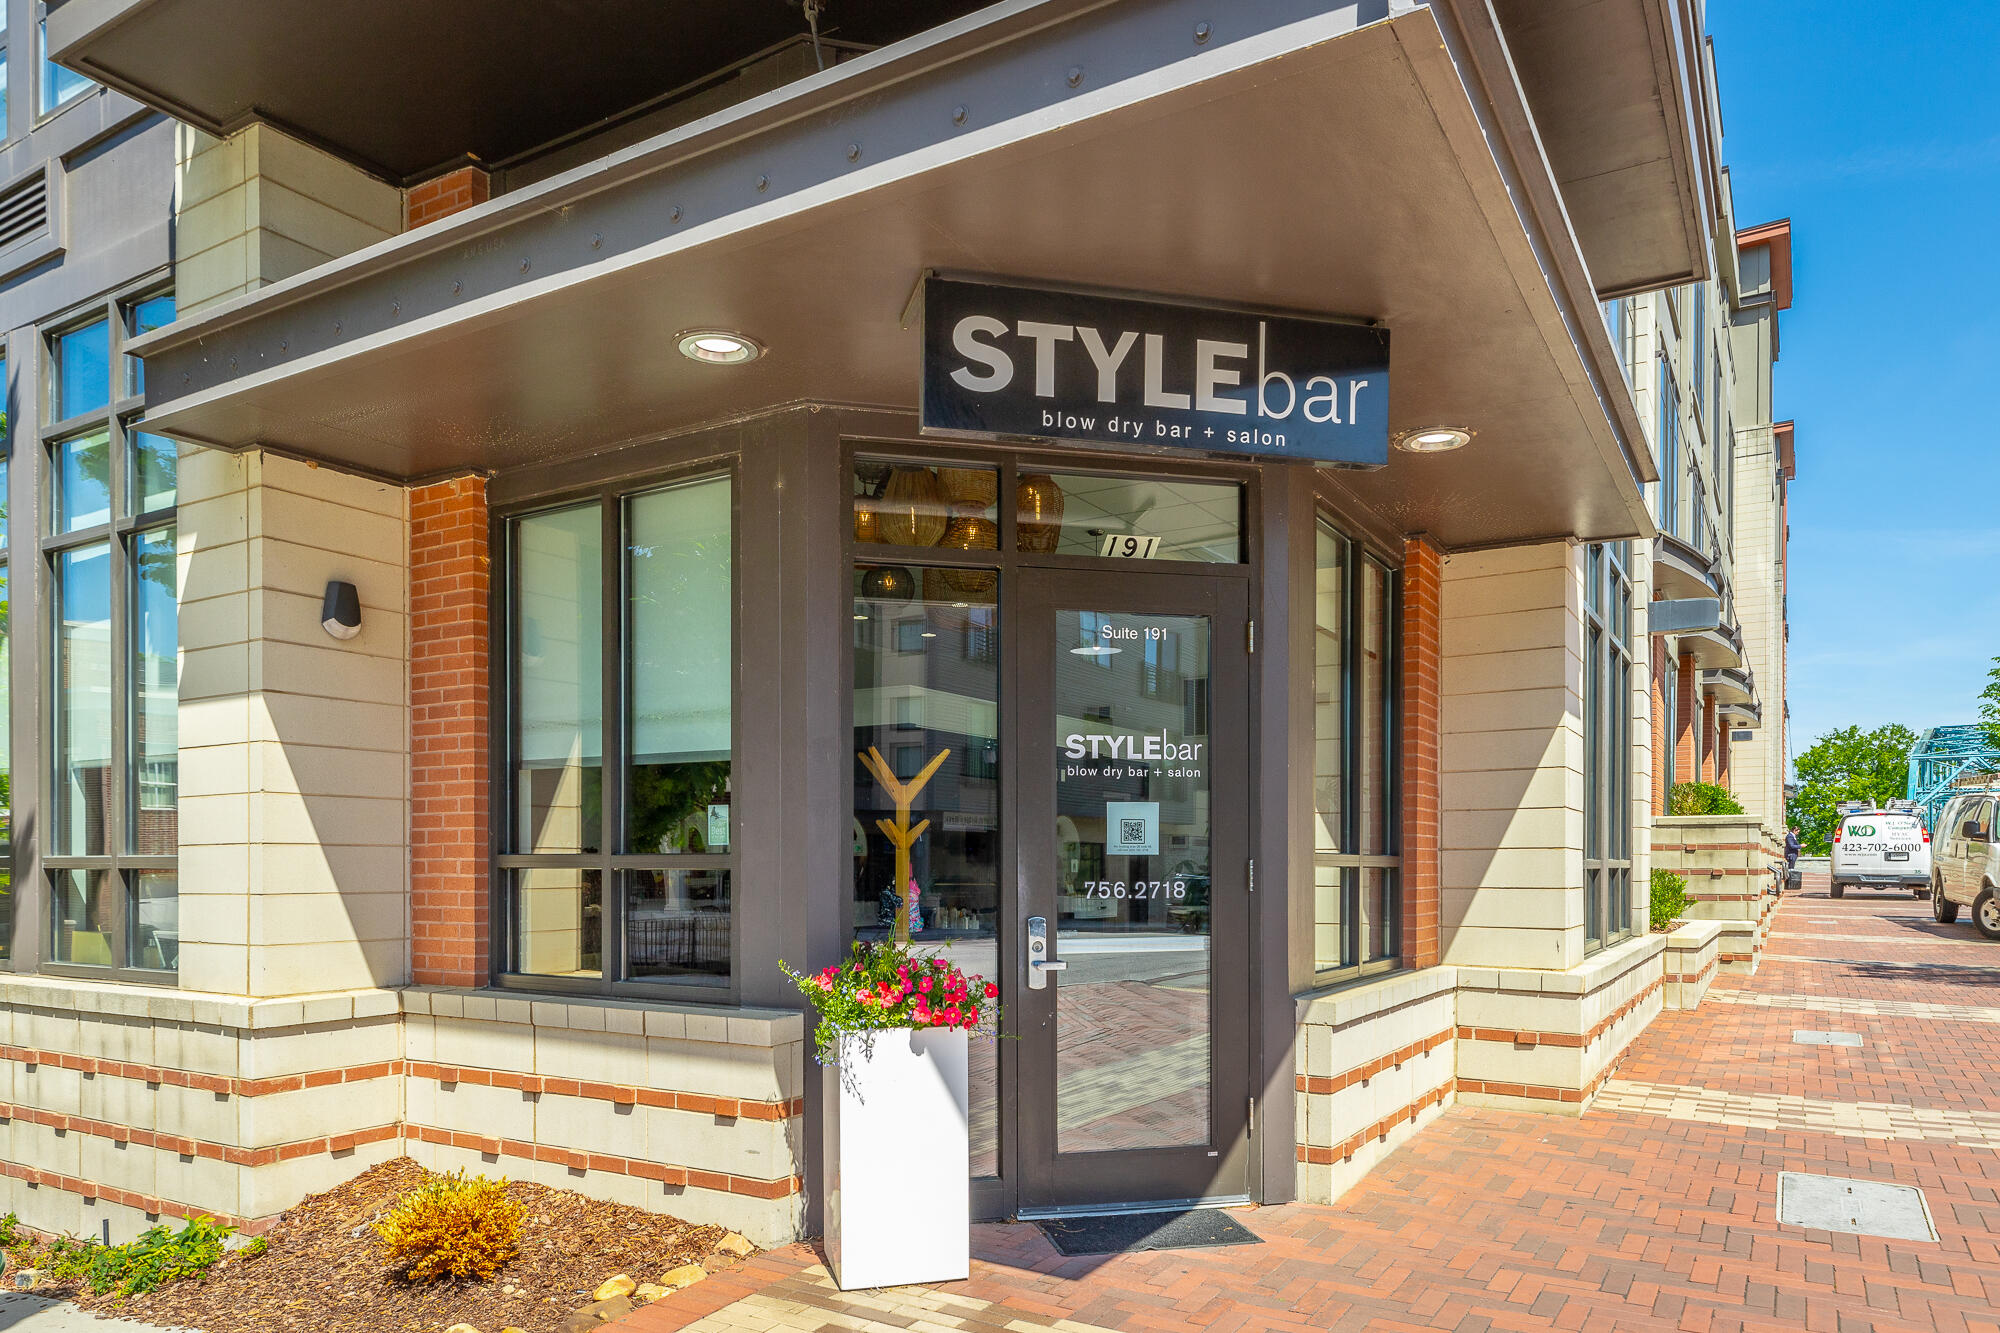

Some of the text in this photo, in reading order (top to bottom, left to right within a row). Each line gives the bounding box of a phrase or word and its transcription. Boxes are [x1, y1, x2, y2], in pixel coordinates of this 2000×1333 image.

[950, 316, 1369, 425] STYLEbar
[1042, 409, 1096, 431] blow
[1107, 416, 1144, 438] dry
[1155, 419, 1192, 439] bar
[1227, 428, 1286, 448] salon
[1107, 535, 1153, 558] 191
[1102, 625, 1168, 641] Suite 191
[1065, 728, 1203, 761] STYLEbar
[1067, 765, 1098, 777] blow
[1103, 765, 1123, 780] dry
[1128, 766, 1149, 777] bar
[1168, 766, 1201, 778] salon
[1842, 843, 1921, 852] 423-702-6000
[1084, 881, 1186, 900] 756.2718
